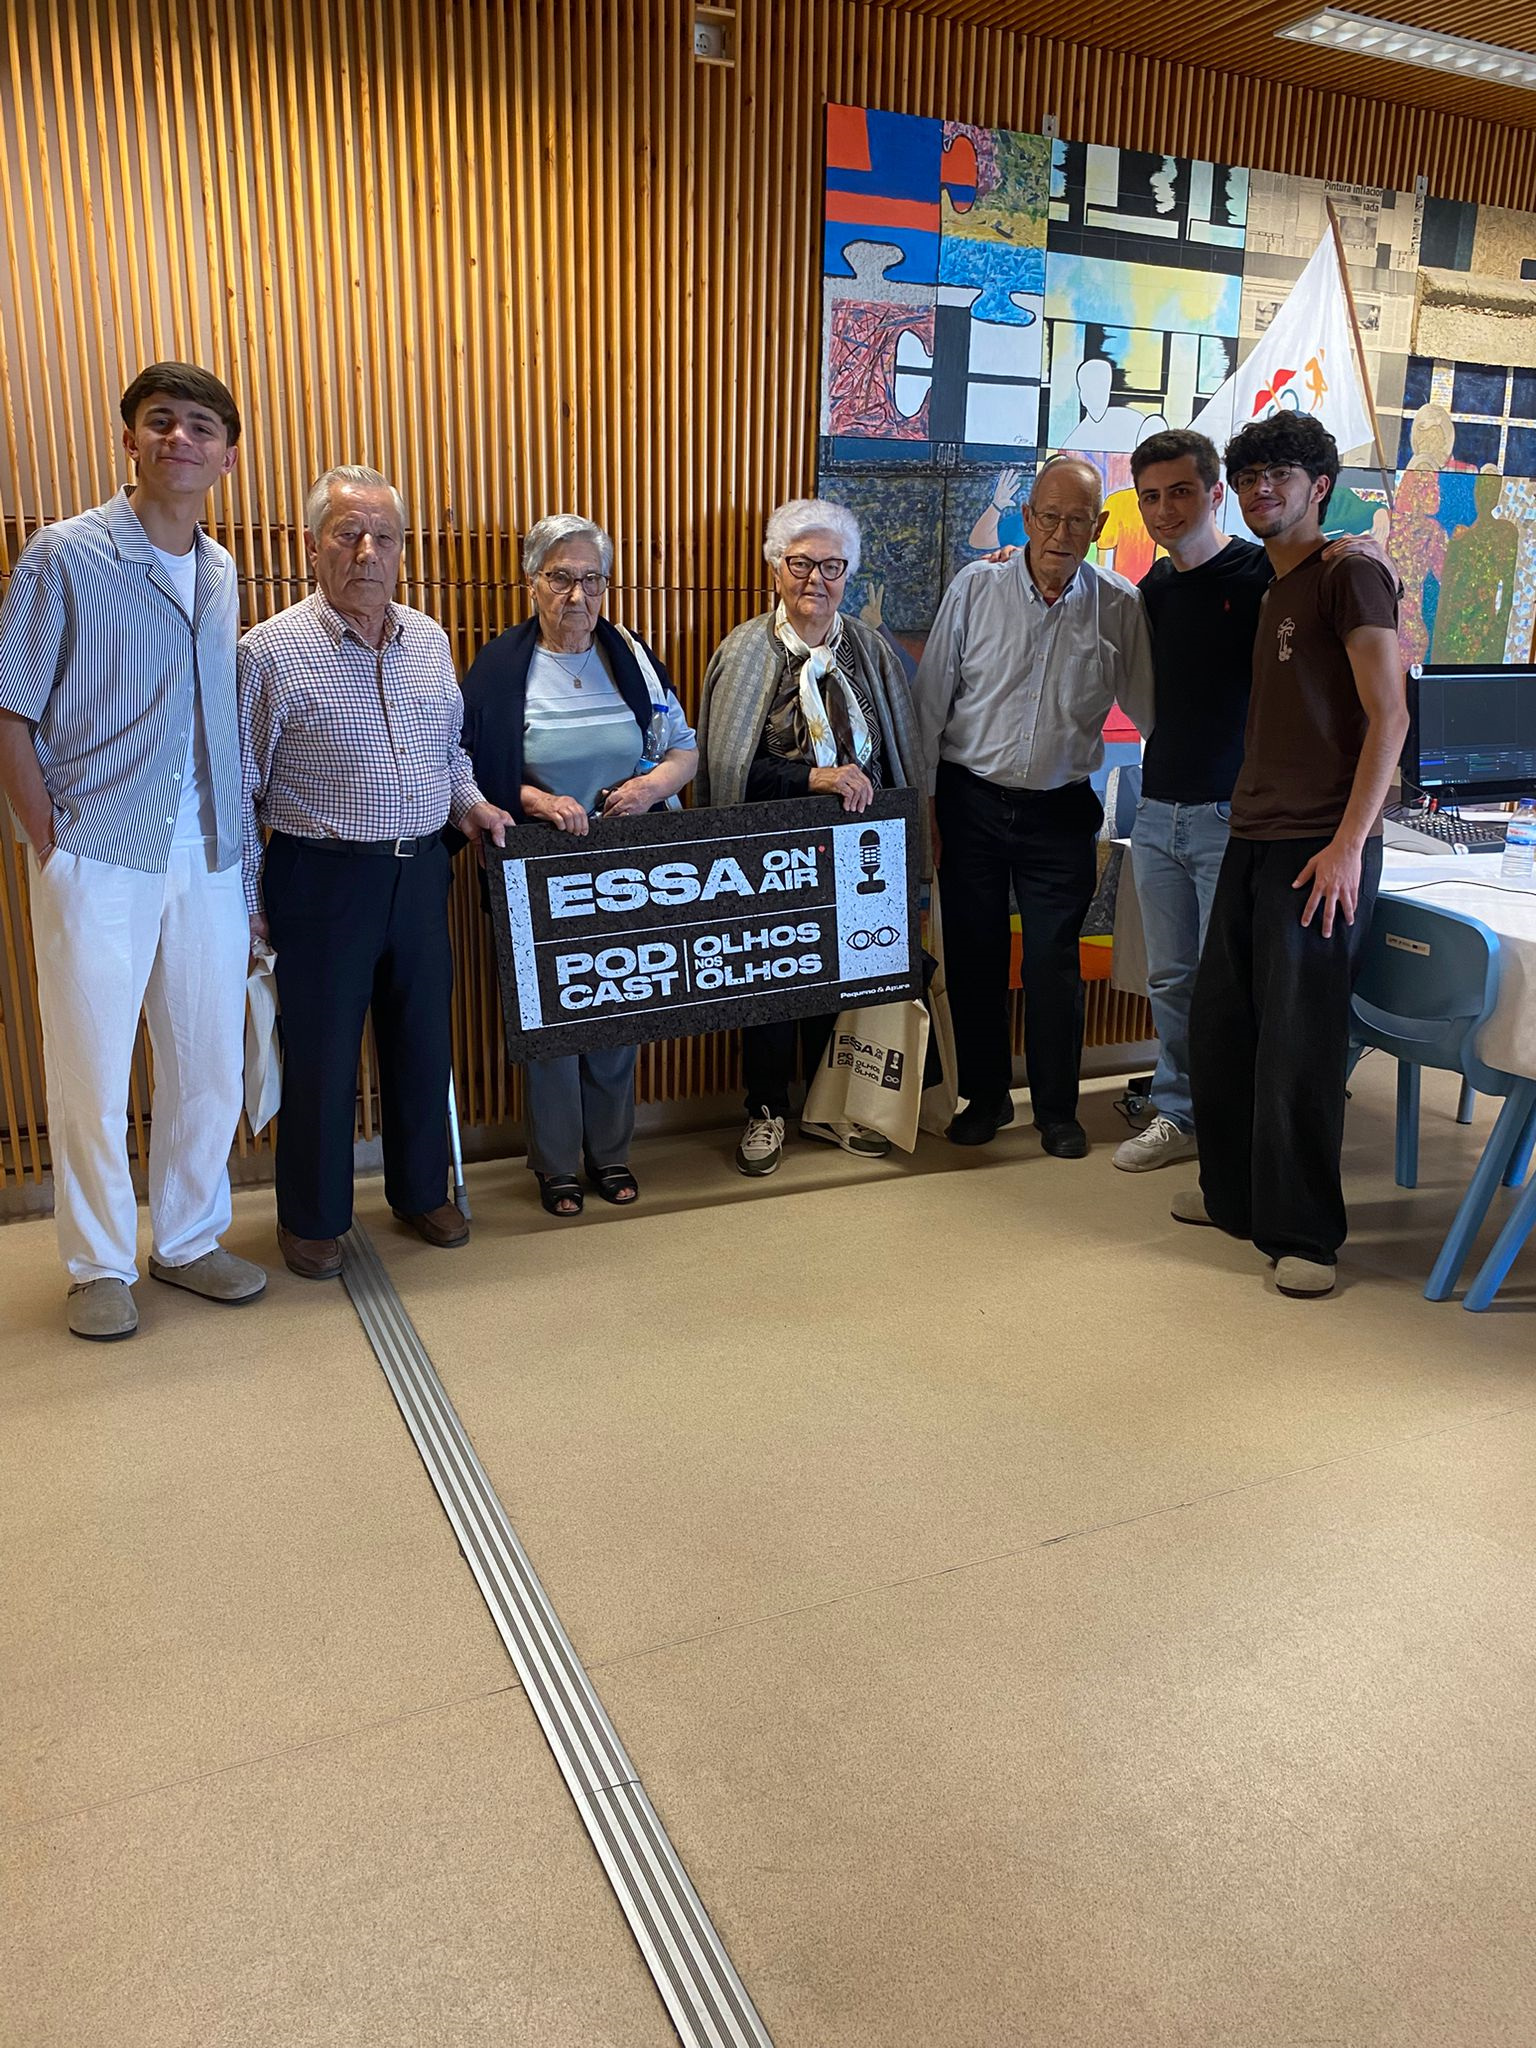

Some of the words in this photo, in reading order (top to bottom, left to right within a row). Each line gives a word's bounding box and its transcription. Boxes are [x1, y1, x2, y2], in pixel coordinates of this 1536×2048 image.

[1324, 180, 1352, 193] Pintura
[762, 846, 817, 871] ON
[546, 856, 755, 919] ESSA
[758, 867, 819, 894] AIR
[692, 922, 821, 957] OLHOS
[555, 941, 678, 986] POD
[694, 955, 724, 970] NOS
[695, 953, 823, 990] OLHOS
[559, 970, 679, 1011] CAST
[885, 983, 911, 992] Apura
[839, 1035, 873, 1056] ESSA
